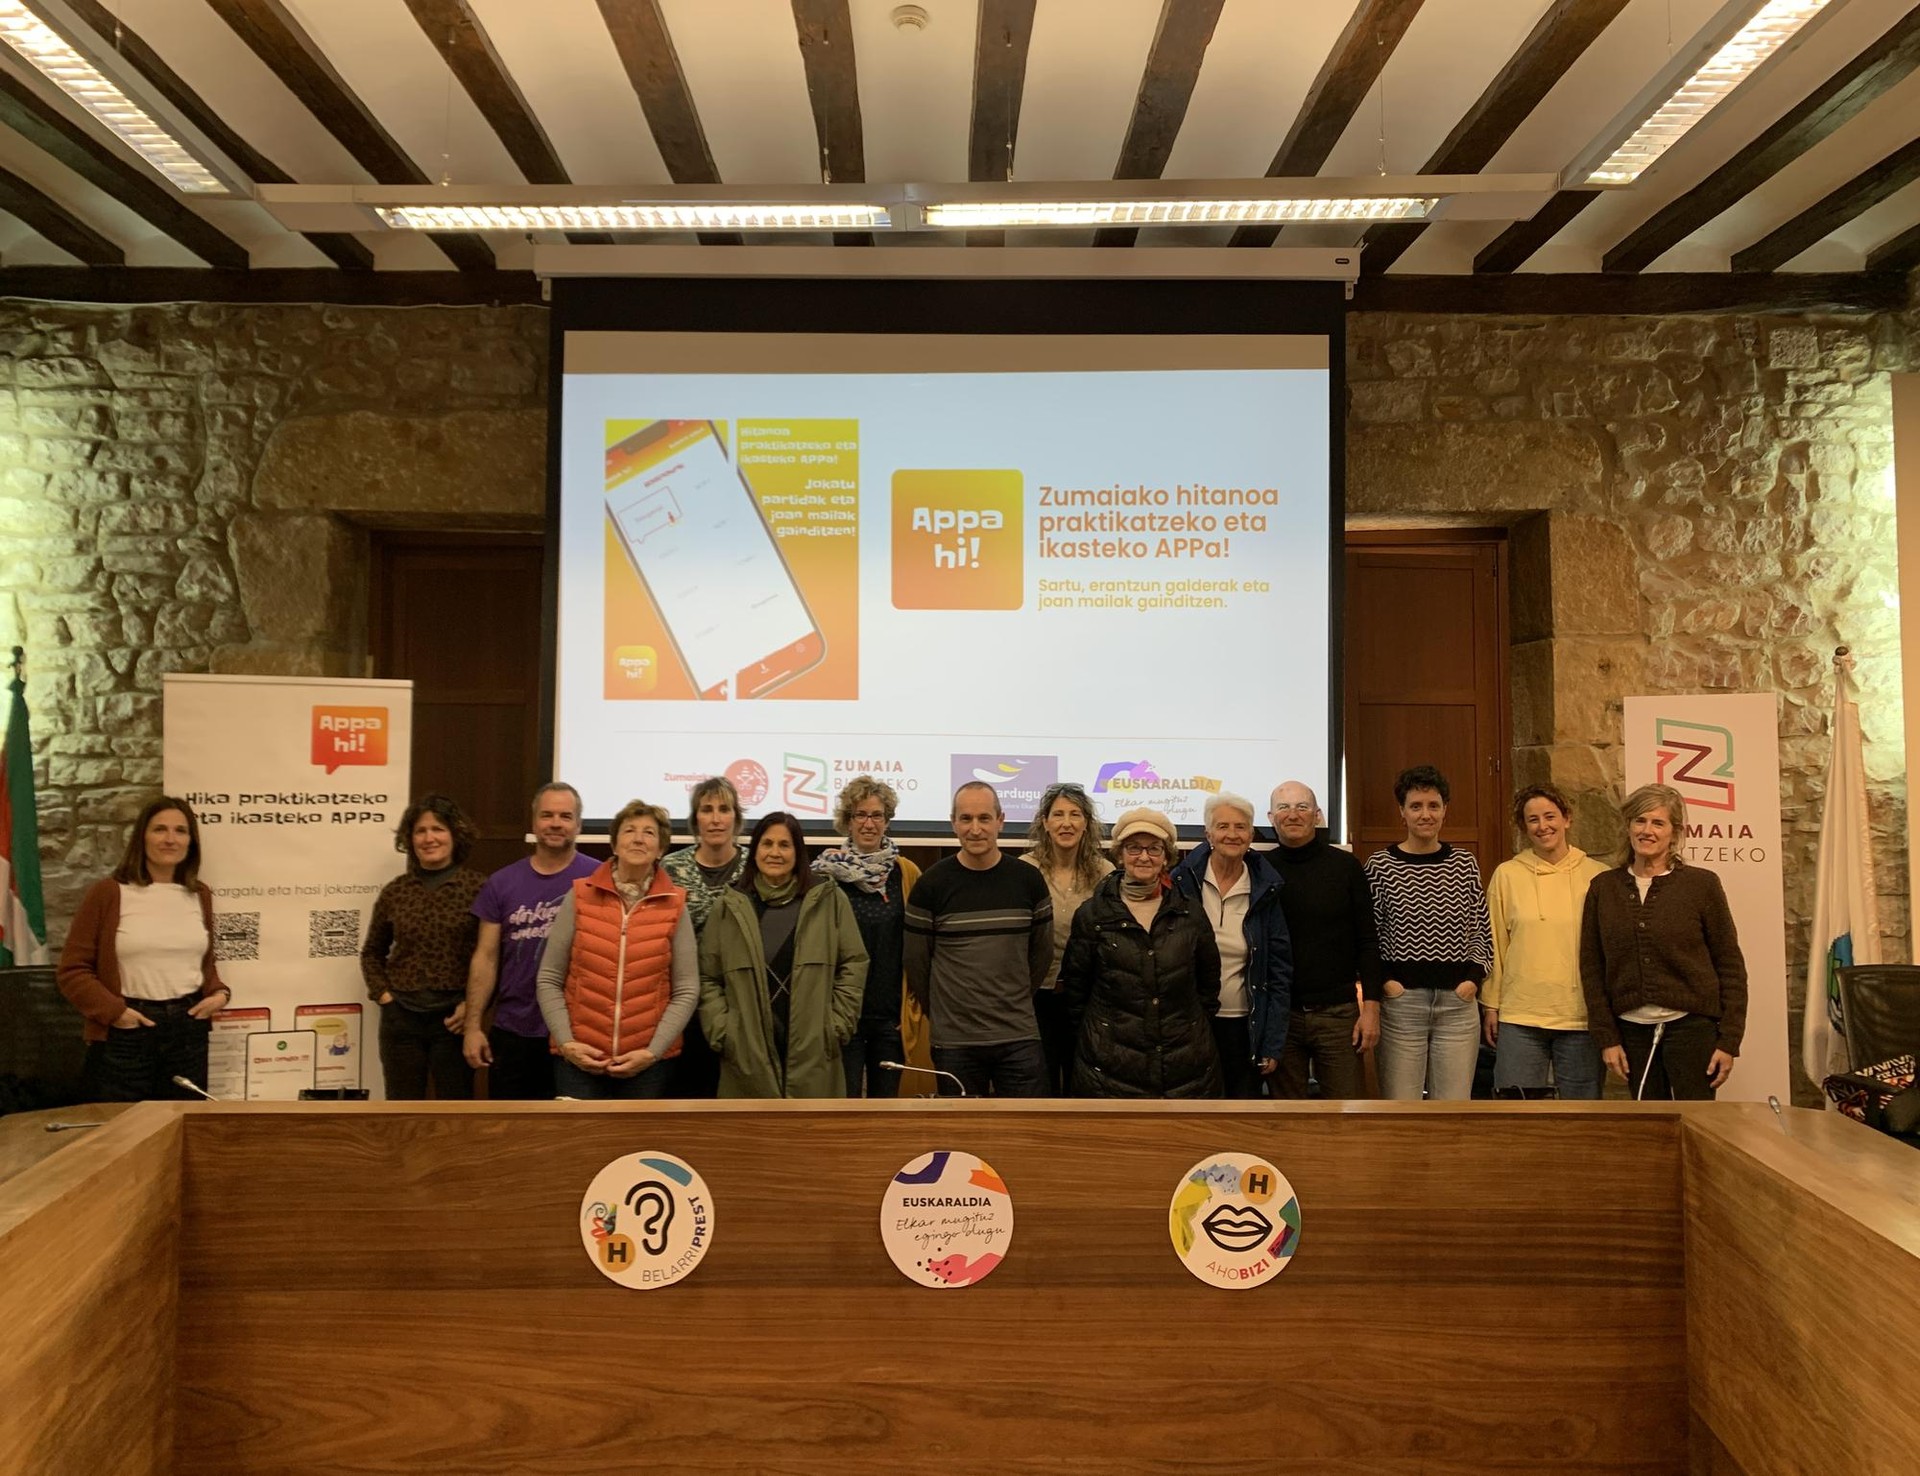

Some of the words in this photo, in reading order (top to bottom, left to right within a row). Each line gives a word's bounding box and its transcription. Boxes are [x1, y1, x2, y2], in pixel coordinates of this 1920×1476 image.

[835, 441, 857, 451] eta
[741, 454, 796, 464] ikasteko
[805, 479, 855, 489] Jokatu
[762, 494, 826, 505] partidak
[831, 495, 855, 505] eta
[1039, 485, 1169, 506] Zumaiako
[1177, 484, 1279, 506] hitanoa
[770, 510, 803, 523] joan
[808, 510, 856, 521] mailak
[912, 507, 1003, 534] Appa
[777, 526, 856, 537] gainditzen!
[1039, 511, 1217, 540] praktikatzeko
[1224, 514, 1267, 532] eta
[934, 537, 980, 569] hi!
[1039, 537, 1148, 559] ikasteko
[1155, 538, 1229, 559] APPa!
[1038, 579, 1085, 593] Sartu,
[1089, 579, 1160, 592] erantzun
[1165, 579, 1238, 596] galderak
[1243, 580, 1270, 592] eta
[1038, 594, 1073, 611] joan
[1078, 594, 1133, 608] mailak
[1137, 594, 1228, 612] gainditzen.
[320, 715, 381, 732] Appa
[333, 734, 366, 753] hi!
[834, 760, 903, 772] ZUMAIA
[1113, 778, 1215, 790] EUSKARALDIA
[186, 792, 229, 805] Hika
[239, 793, 388, 808] praktikatzeko
[231, 812, 322, 825] ikasteko
[331, 812, 385, 824] APPa
[1686, 824, 1753, 838] MAIA
[268, 885, 290, 896] eta
[295, 884, 321, 895] hasi
[1249, 1174, 1268, 1194] H
[903, 1197, 991, 1207] EUSKARALDIA
[896, 1217, 933, 1231] Elkar
[941, 1213, 994, 1233] mugituz
[915, 1229, 960, 1250] egingo
[965, 1224, 1005, 1244] dugu
[607, 1242, 627, 1263] H
